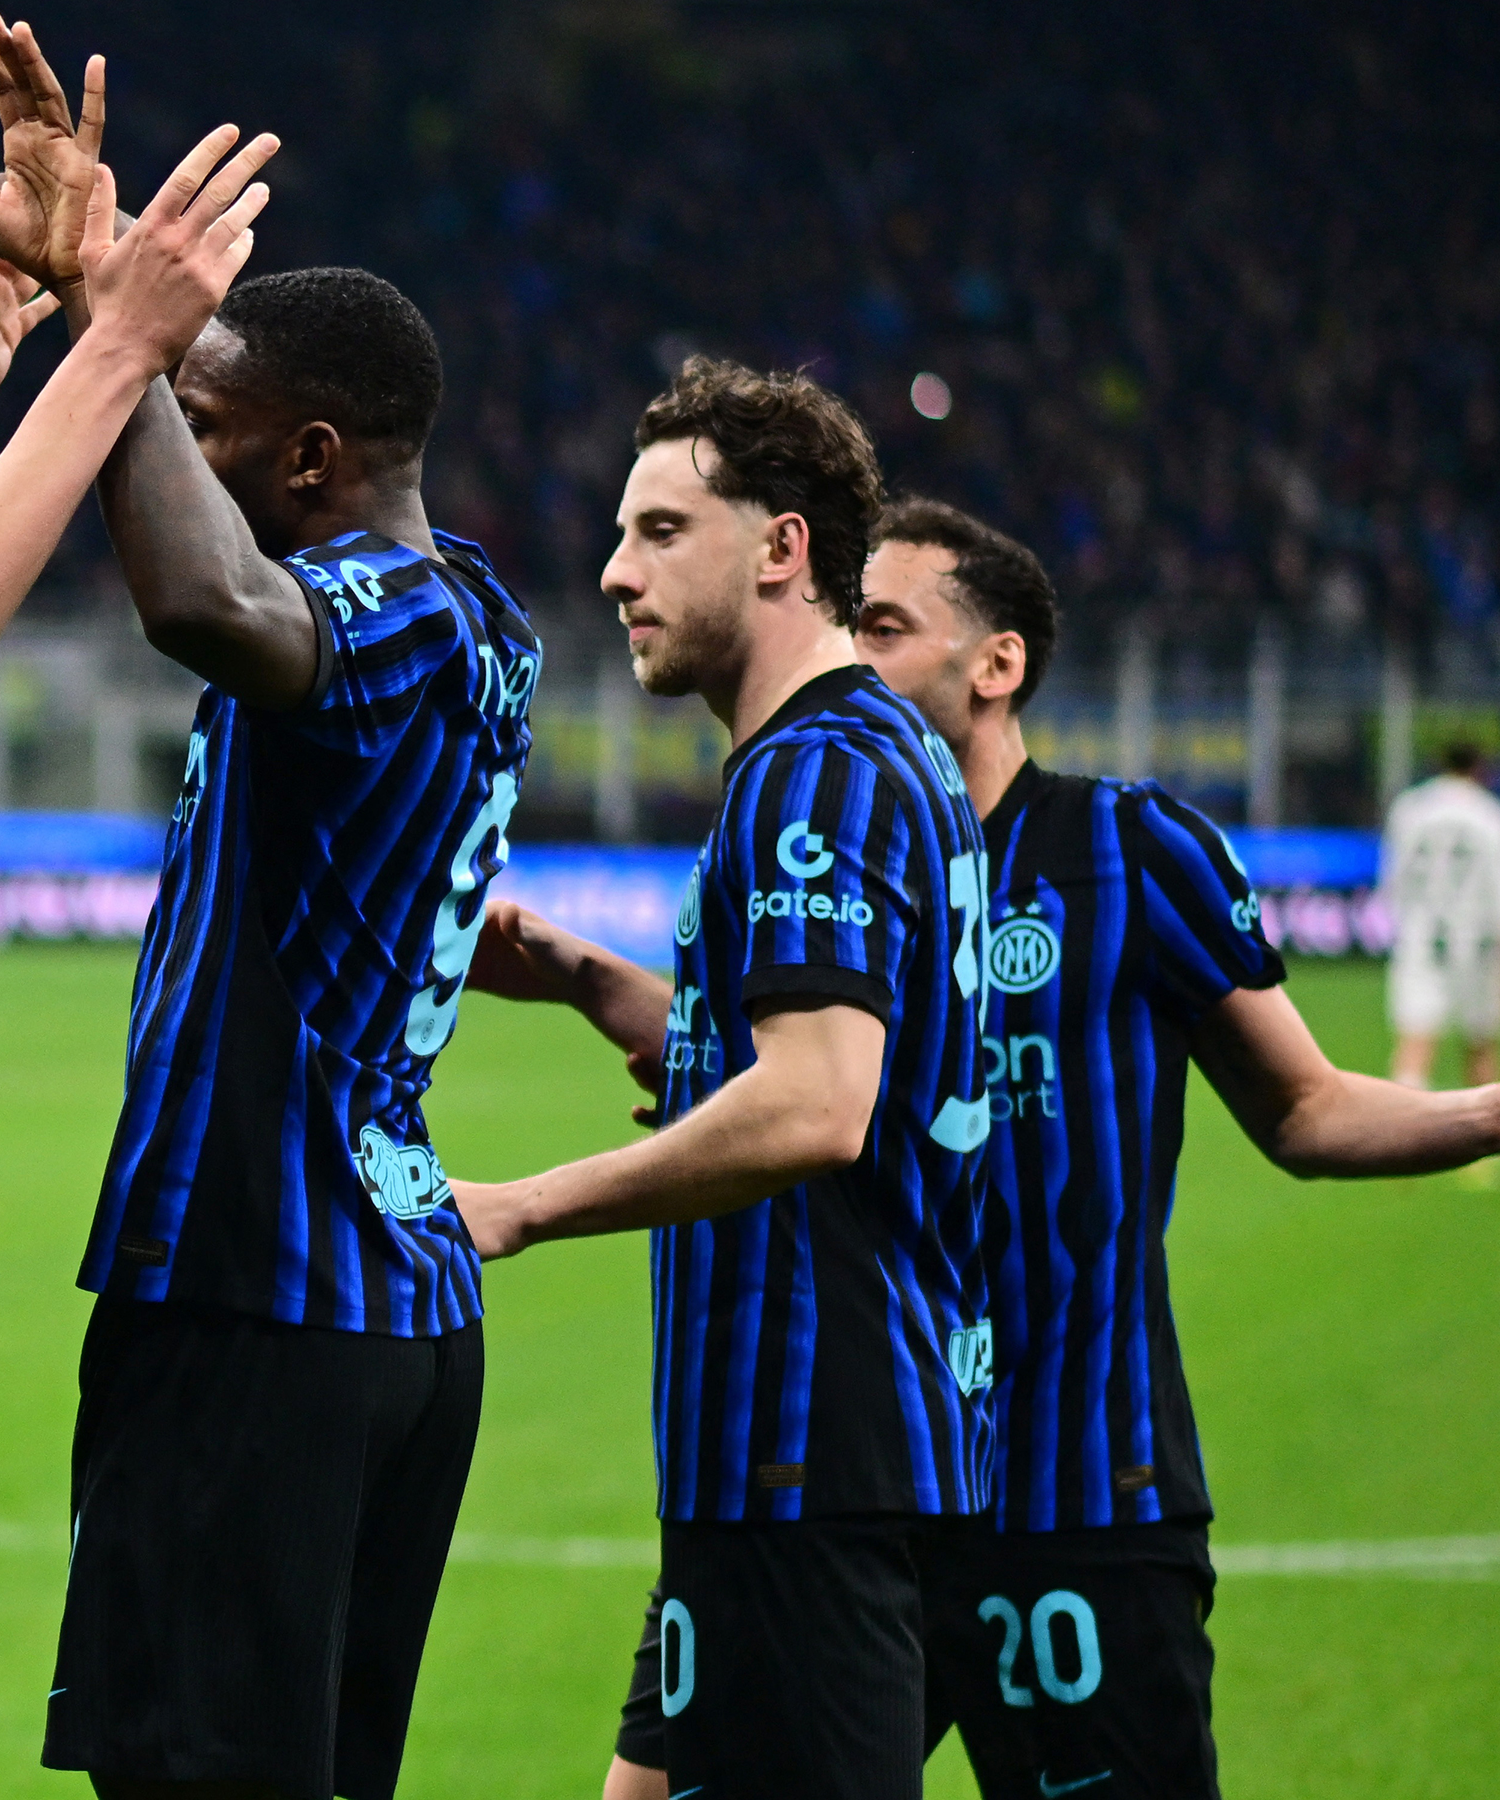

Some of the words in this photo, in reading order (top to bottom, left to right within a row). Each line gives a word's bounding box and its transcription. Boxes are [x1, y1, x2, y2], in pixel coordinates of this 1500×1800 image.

[748, 889, 874, 928] Gate.io
[982, 1033, 1057, 1084] on
[988, 1080, 1059, 1122] ort
[660, 1597, 695, 1718] 0
[977, 1589, 1102, 1708] 20
